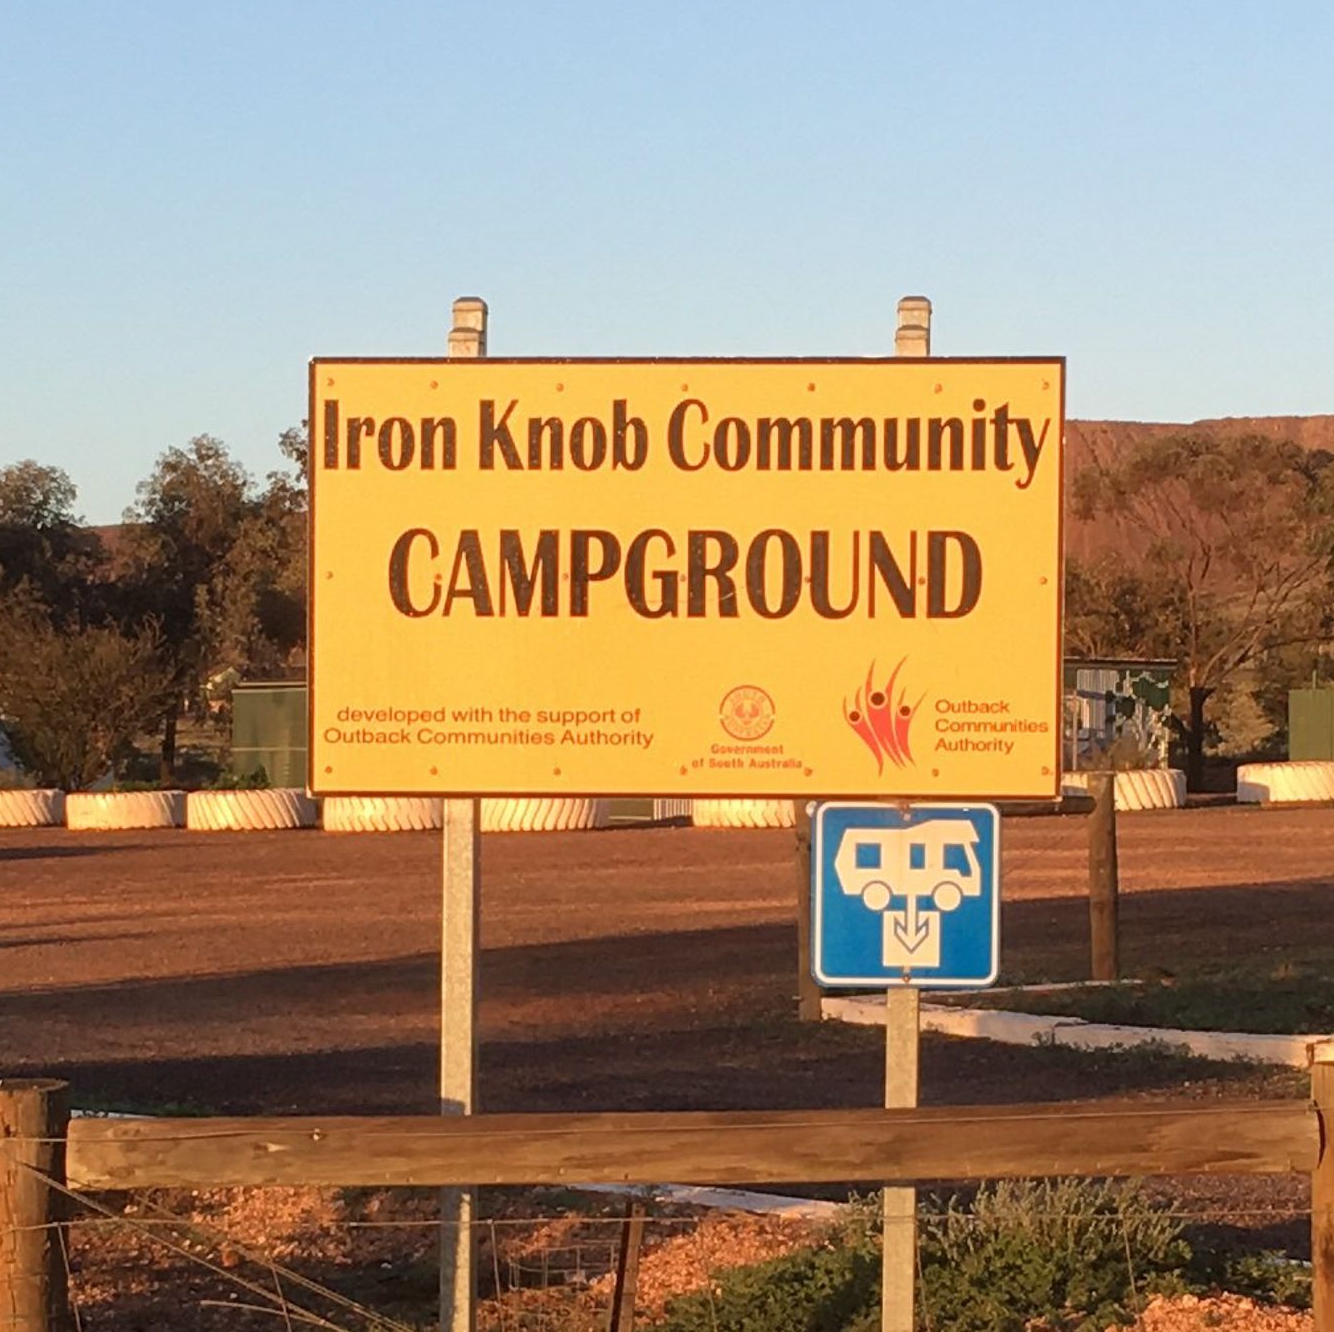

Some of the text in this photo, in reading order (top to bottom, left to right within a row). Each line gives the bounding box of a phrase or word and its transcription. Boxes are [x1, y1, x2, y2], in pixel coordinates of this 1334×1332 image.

[323, 398, 1051, 489] Iron Knob Community
[388, 527, 983, 619] CAMPGROUND
[935, 699, 1011, 714] Outback
[337, 706, 641, 727] developed with the support of
[935, 718, 1049, 733] Communities
[323, 727, 654, 750] Outback Communities Authority
[934, 738, 1014, 755] Authority
[710, 743, 784, 755] Government
[691, 758, 803, 769] of South Australia
